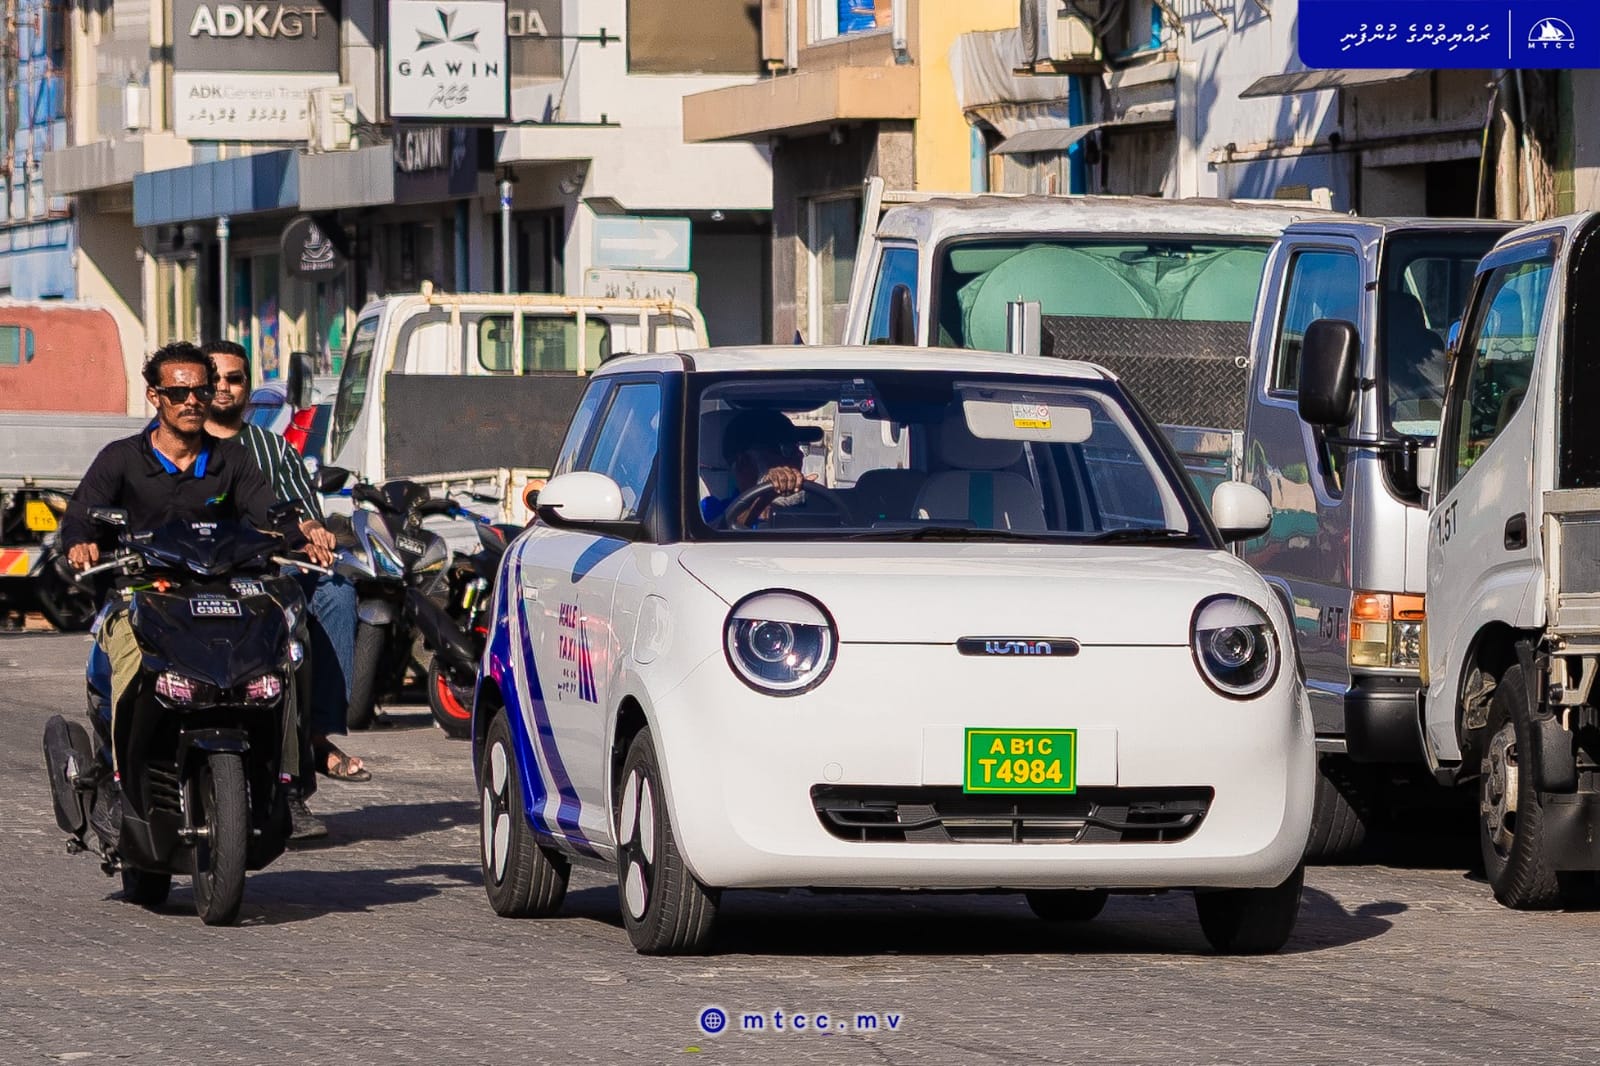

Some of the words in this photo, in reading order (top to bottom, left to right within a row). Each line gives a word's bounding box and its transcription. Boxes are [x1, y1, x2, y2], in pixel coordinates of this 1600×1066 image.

[398, 60, 498, 77] GAWIN
[190, 85, 221, 99] ADK
[406, 127, 442, 171] GAWIN
[1437, 500, 1458, 546] 1.5T
[1318, 606, 1343, 640] 1.5T
[559, 635, 576, 662] TAXI
[979, 759, 1063, 784] T4984
